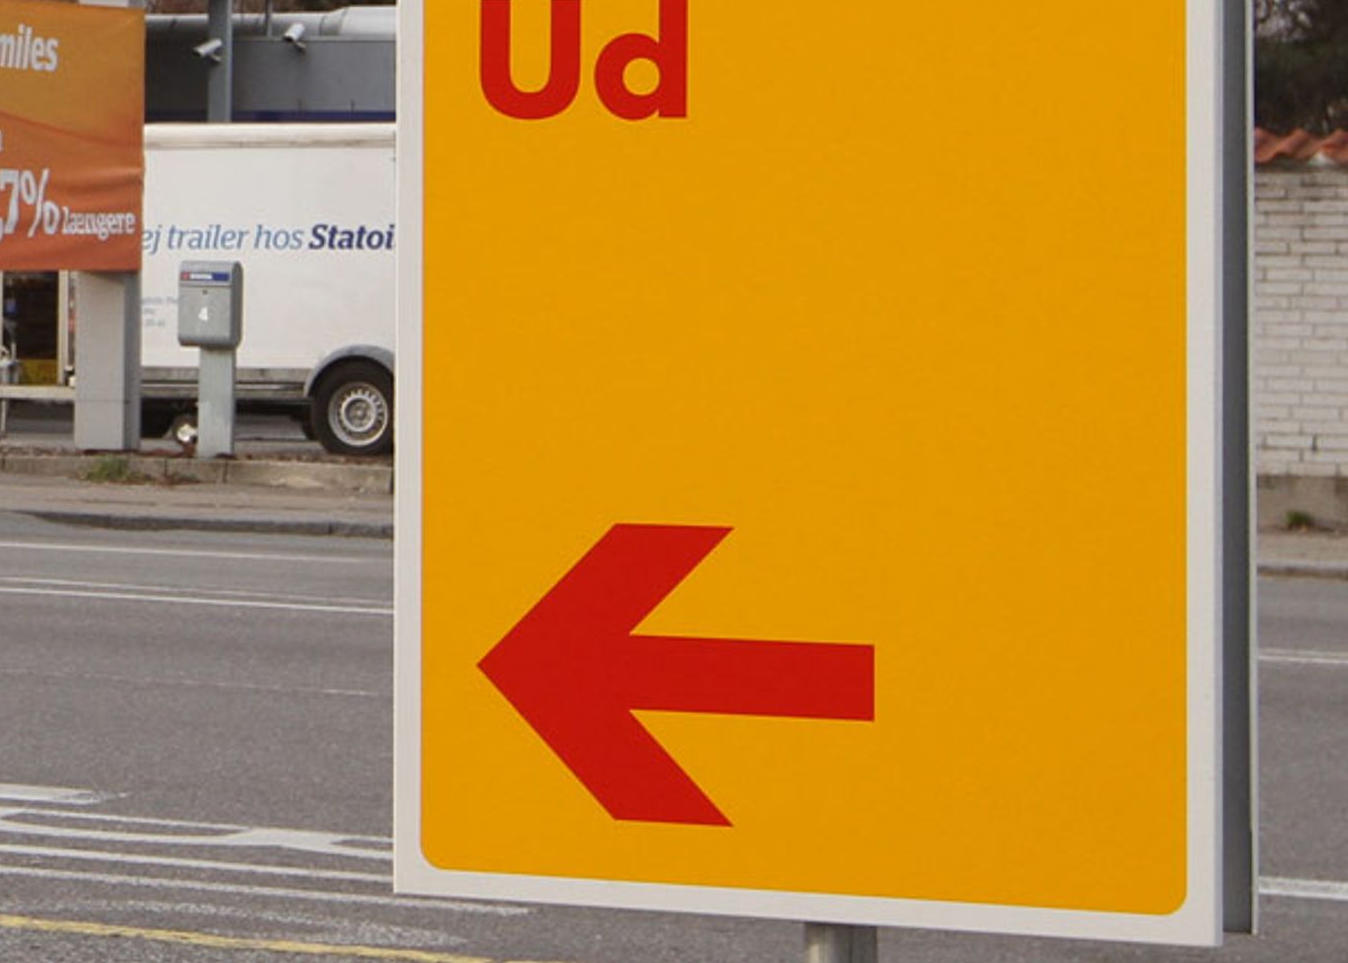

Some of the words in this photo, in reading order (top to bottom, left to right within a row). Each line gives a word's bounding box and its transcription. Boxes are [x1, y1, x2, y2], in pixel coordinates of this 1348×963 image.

[62, 206, 136, 241] længere
[141, 225, 161, 255] ej
[167, 224, 249, 249] trailer
[254, 224, 302, 249] hos
[308, 223, 396, 250] Statoi
